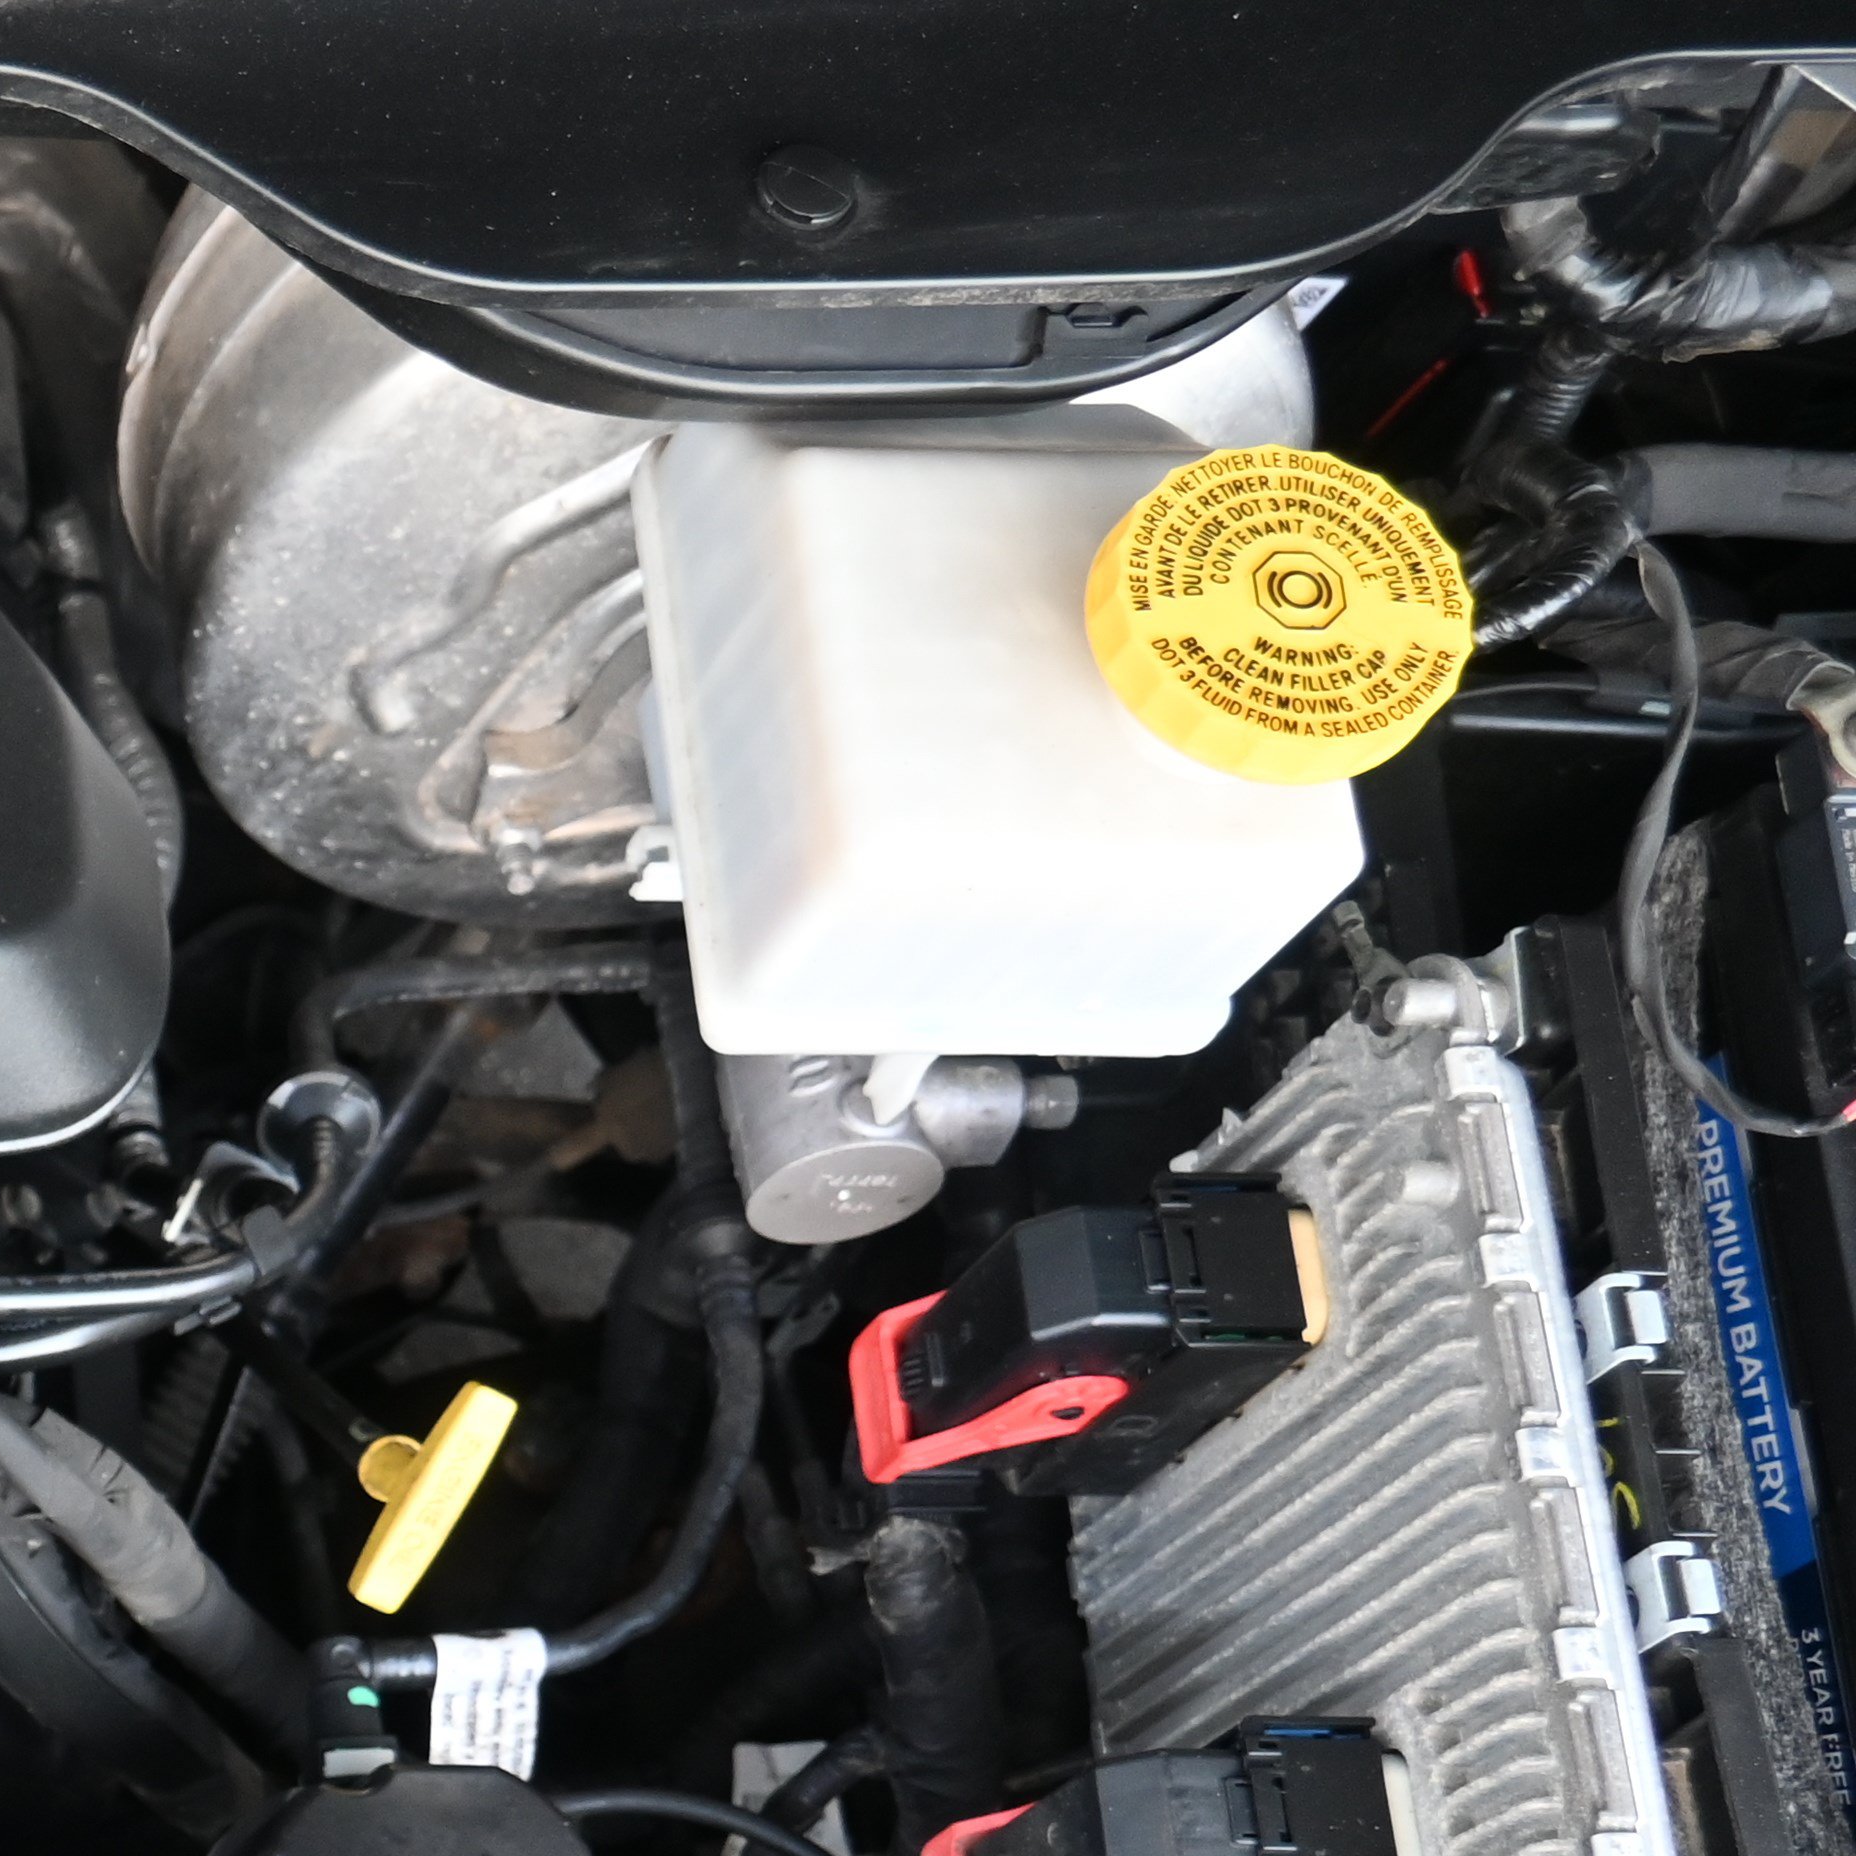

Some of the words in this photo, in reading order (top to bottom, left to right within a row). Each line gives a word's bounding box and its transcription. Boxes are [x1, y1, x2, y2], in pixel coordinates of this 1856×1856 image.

[1170, 453, 1256, 497] NETTOYER
[1261, 452, 1283, 468] LE
[1289, 454, 1377, 496] BOUCHON
[1177, 504, 1202, 526] LE
[1226, 499, 1263, 522] DOT
[1269, 498, 1281, 512] 3
[1279, 477, 1361, 513] UTILISER
[1378, 491, 1404, 514] DE
[1163, 523, 1188, 547] DE
[1184, 515, 1230, 571] LIQUIDE
[1210, 519, 1304, 584] CONTENANT
[1285, 498, 1392, 561] PROVENANT
[1129, 547, 1149, 570] EN
[1156, 545, 1178, 598] AVANT
[1362, 508, 1435, 606] UNIQUEMENT
[1401, 512, 1463, 620] REMPLISSAGE
[1129, 575, 1152, 611] MISE
[1182, 574, 1203, 596] DU
[1151, 638, 1186, 668] DOT
[1179, 670, 1196, 682] 3
[1191, 679, 1242, 716] FLUID
[1244, 707, 1298, 735] FROM
[1304, 722, 1315, 737] A
[1321, 712, 1389, 737] SEALED
[1179, 637, 1245, 694] BEFORE
[1361, 678, 1398, 705] USE
[1394, 642, 1429, 682] ONLY
[1223, 648, 1284, 686] CLEAN
[1290, 670, 1356, 692] FILLER
[1356, 650, 1387, 679] CAP
[1693, 1119, 1750, 1314] PREMIUM
[1730, 1323, 1791, 1515] BATTERY
[1801, 1628, 1821, 1645] 3
[1806, 1650, 1836, 1726] YEAR
[1822, 1733, 1853, 1806] FREE
